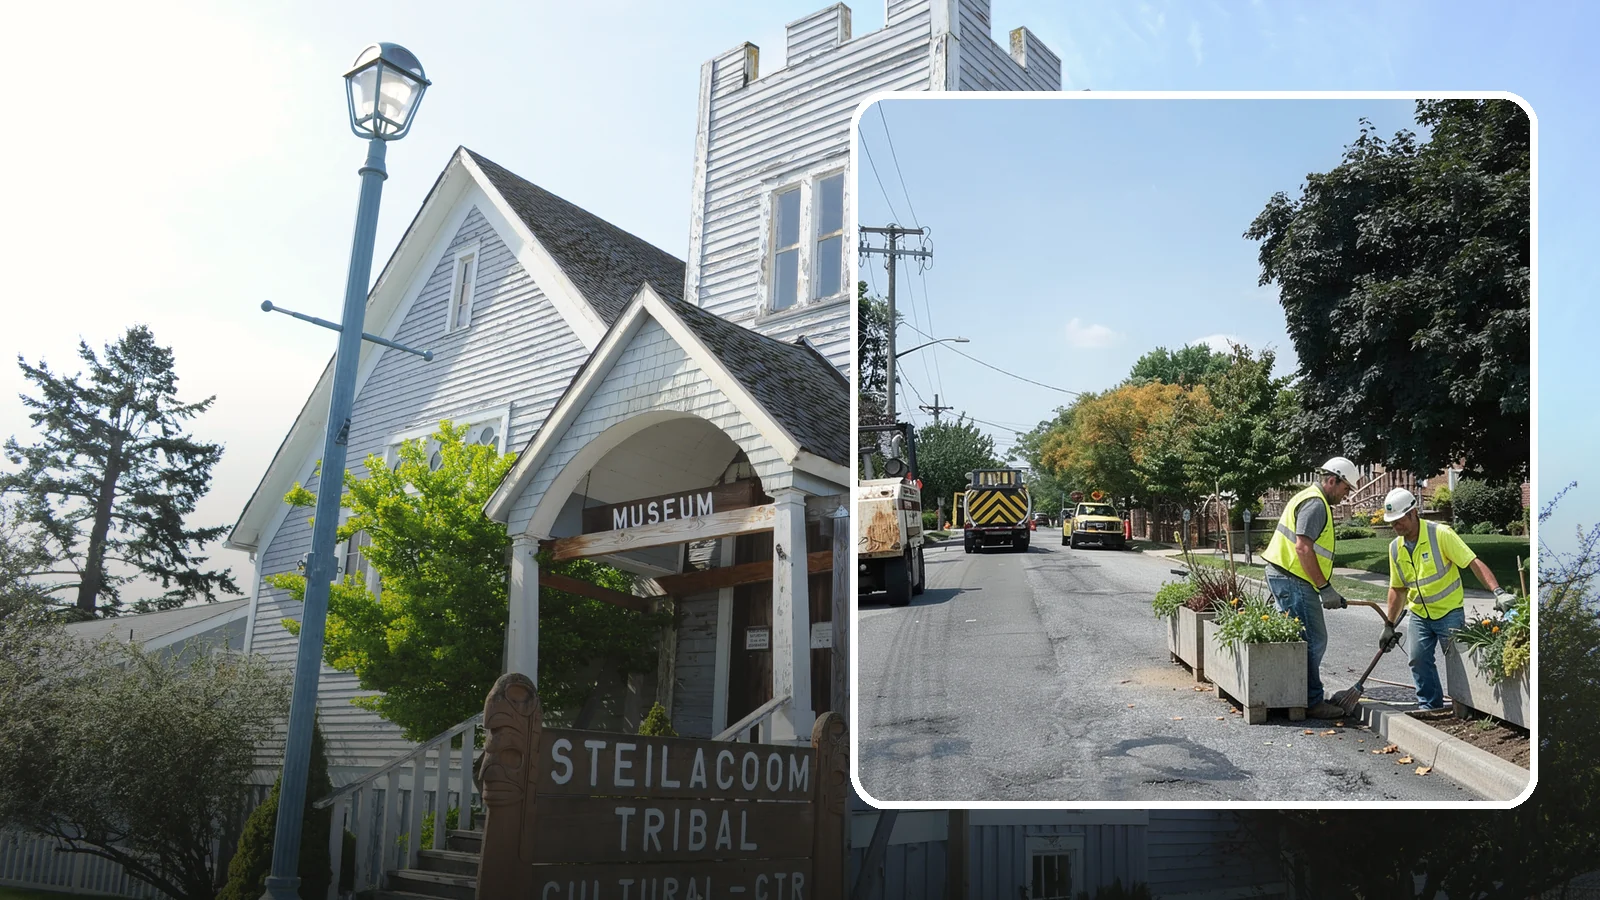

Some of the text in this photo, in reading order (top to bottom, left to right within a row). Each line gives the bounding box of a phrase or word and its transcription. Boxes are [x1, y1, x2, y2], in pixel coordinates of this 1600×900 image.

[613, 491, 713, 531] MUSEUM
[550, 738, 810, 792] STEILACOOM
[615, 806, 757, 852] TRIBAL
